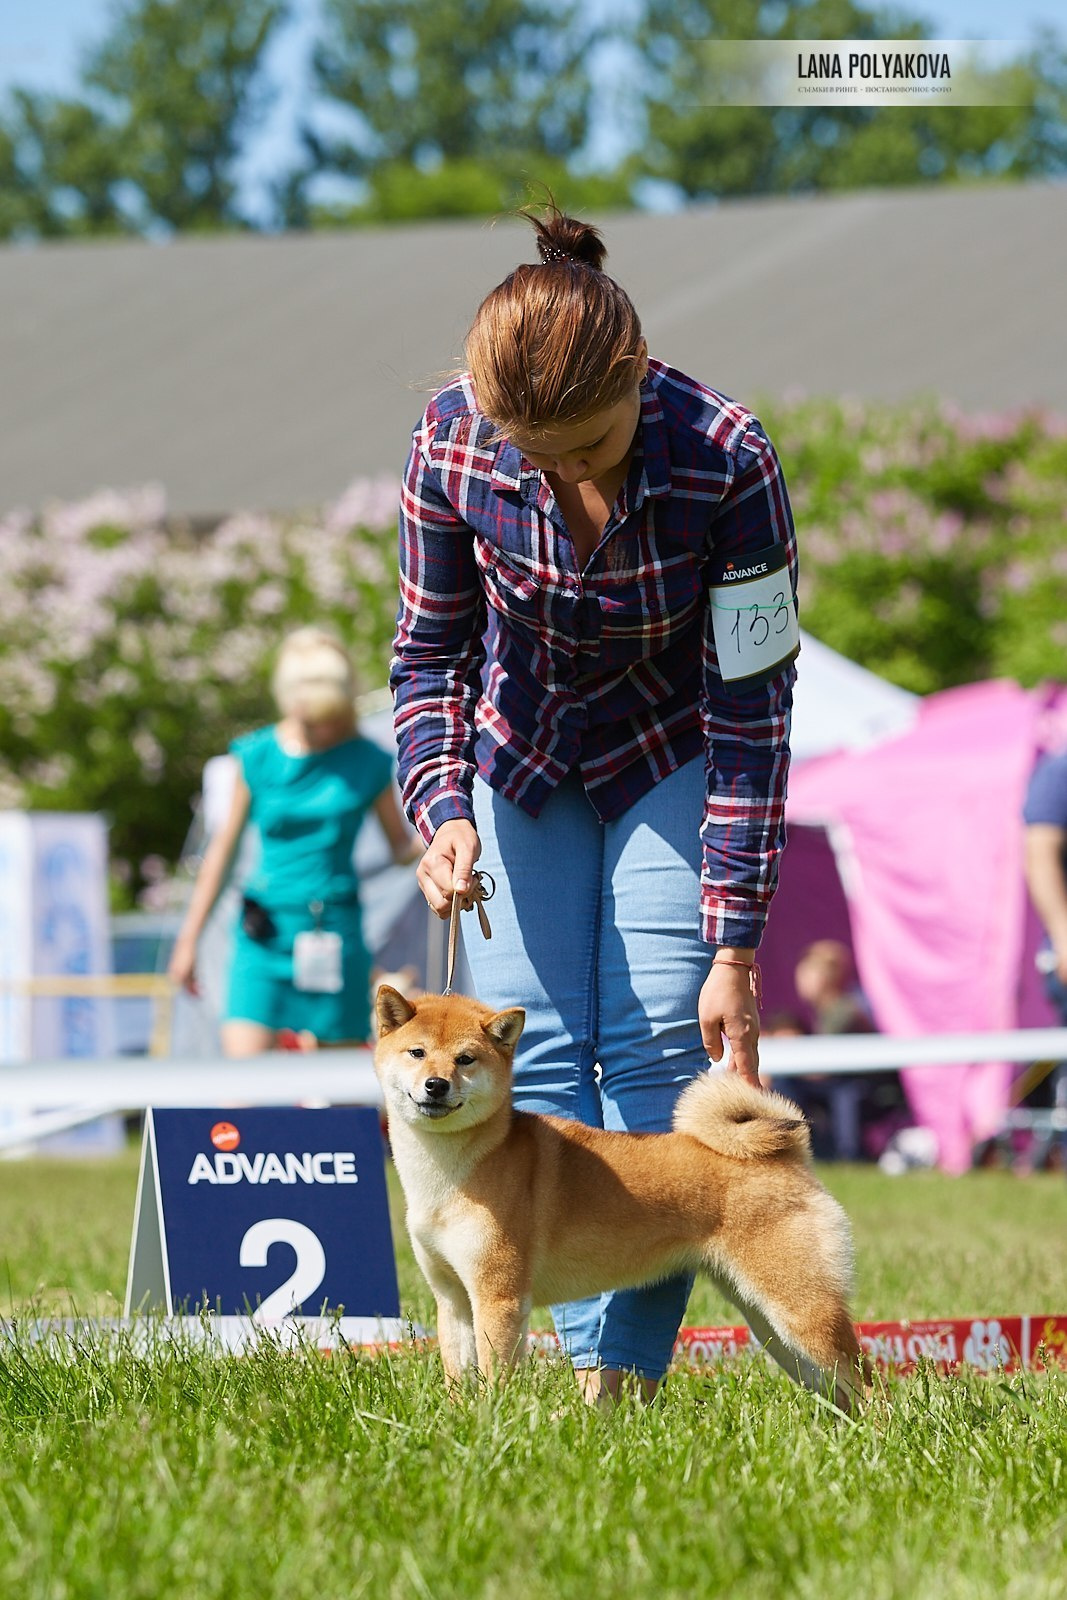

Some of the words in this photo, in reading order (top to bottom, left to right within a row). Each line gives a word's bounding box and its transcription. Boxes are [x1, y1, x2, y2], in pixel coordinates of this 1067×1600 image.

[722, 562, 768, 581] ADVANCE
[730, 591, 790, 654] 133
[187, 1152, 359, 1185] ADVANCE
[239, 1217, 327, 1324] 2
